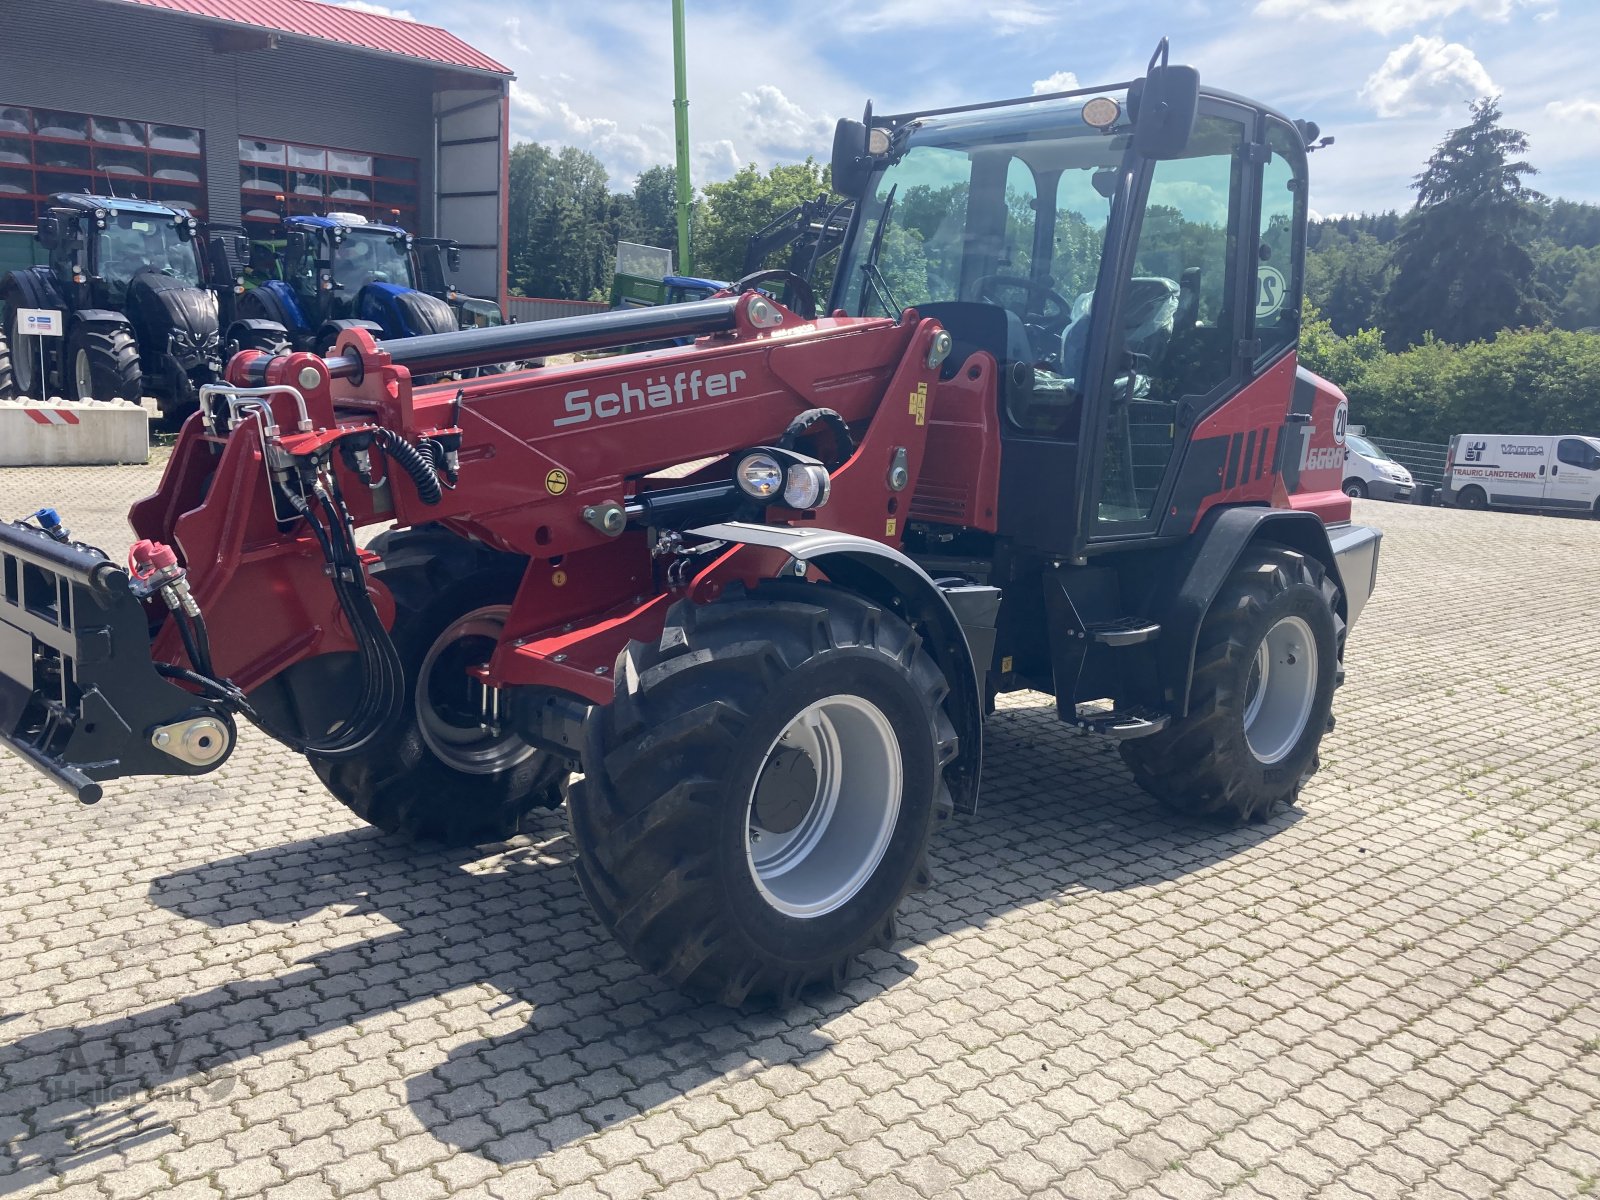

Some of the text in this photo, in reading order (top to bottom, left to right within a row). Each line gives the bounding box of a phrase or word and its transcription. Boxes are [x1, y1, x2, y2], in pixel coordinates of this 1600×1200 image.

[554, 369, 746, 427] Schäffer
[1335, 409, 1346, 436] 20
[1453, 468, 1536, 479] TRAURIG LANDTECHNIK
